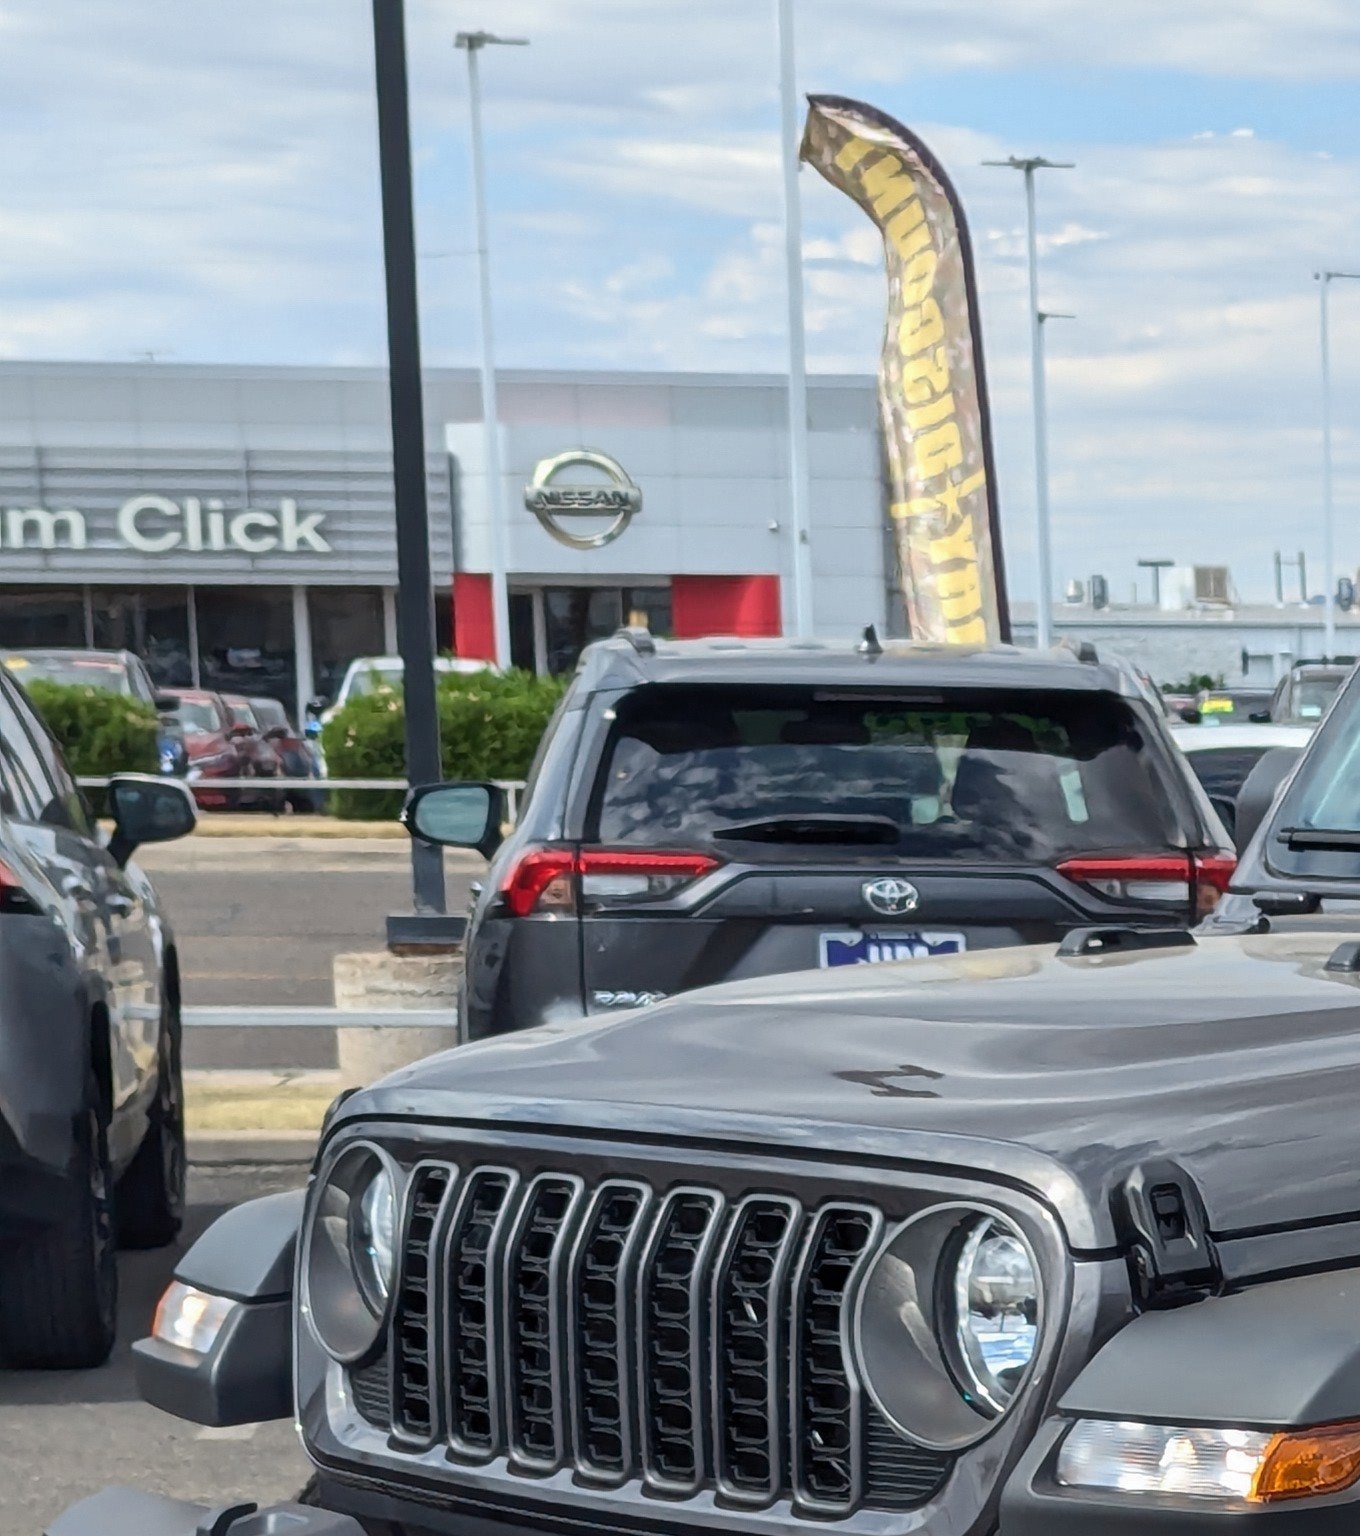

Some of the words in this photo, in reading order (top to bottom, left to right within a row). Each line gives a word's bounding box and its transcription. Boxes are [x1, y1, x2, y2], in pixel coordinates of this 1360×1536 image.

[534, 489, 631, 507] NISSAN
[0, 508, 87, 550] m
[118, 494, 333, 553] Click
